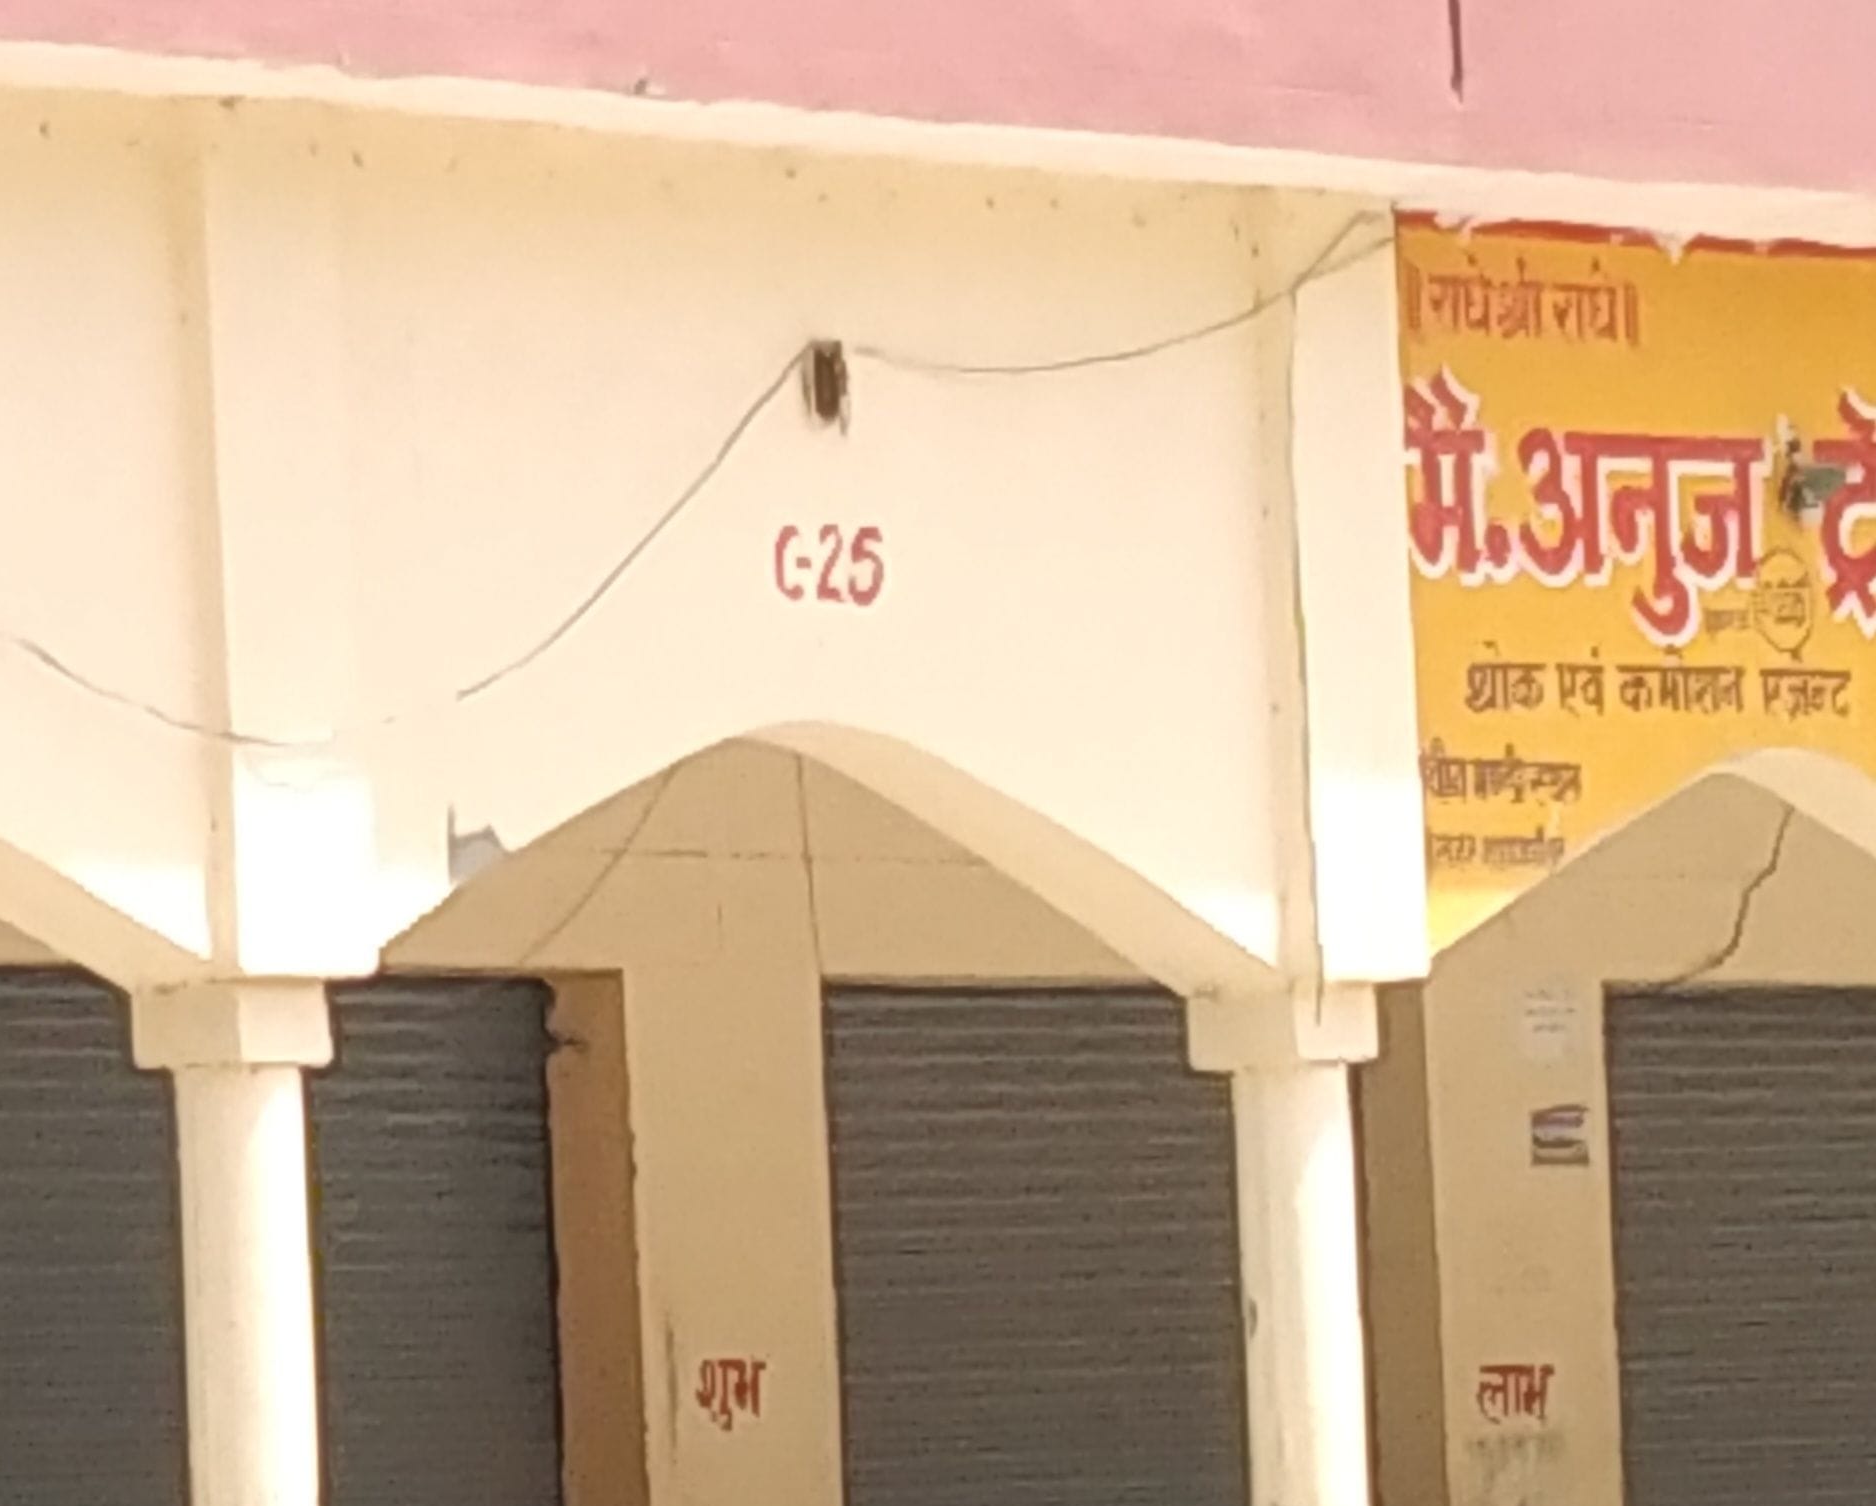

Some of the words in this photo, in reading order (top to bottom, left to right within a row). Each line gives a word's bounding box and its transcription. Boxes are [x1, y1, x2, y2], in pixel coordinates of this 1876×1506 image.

[774, 523, 884, 607] C-25
[1464, 640, 1546, 713] थोक
[1555, 645, 1604, 717] एवं
[695, 1359, 766, 1431] शुभ
[1477, 1365, 1555, 1424] लाभ
